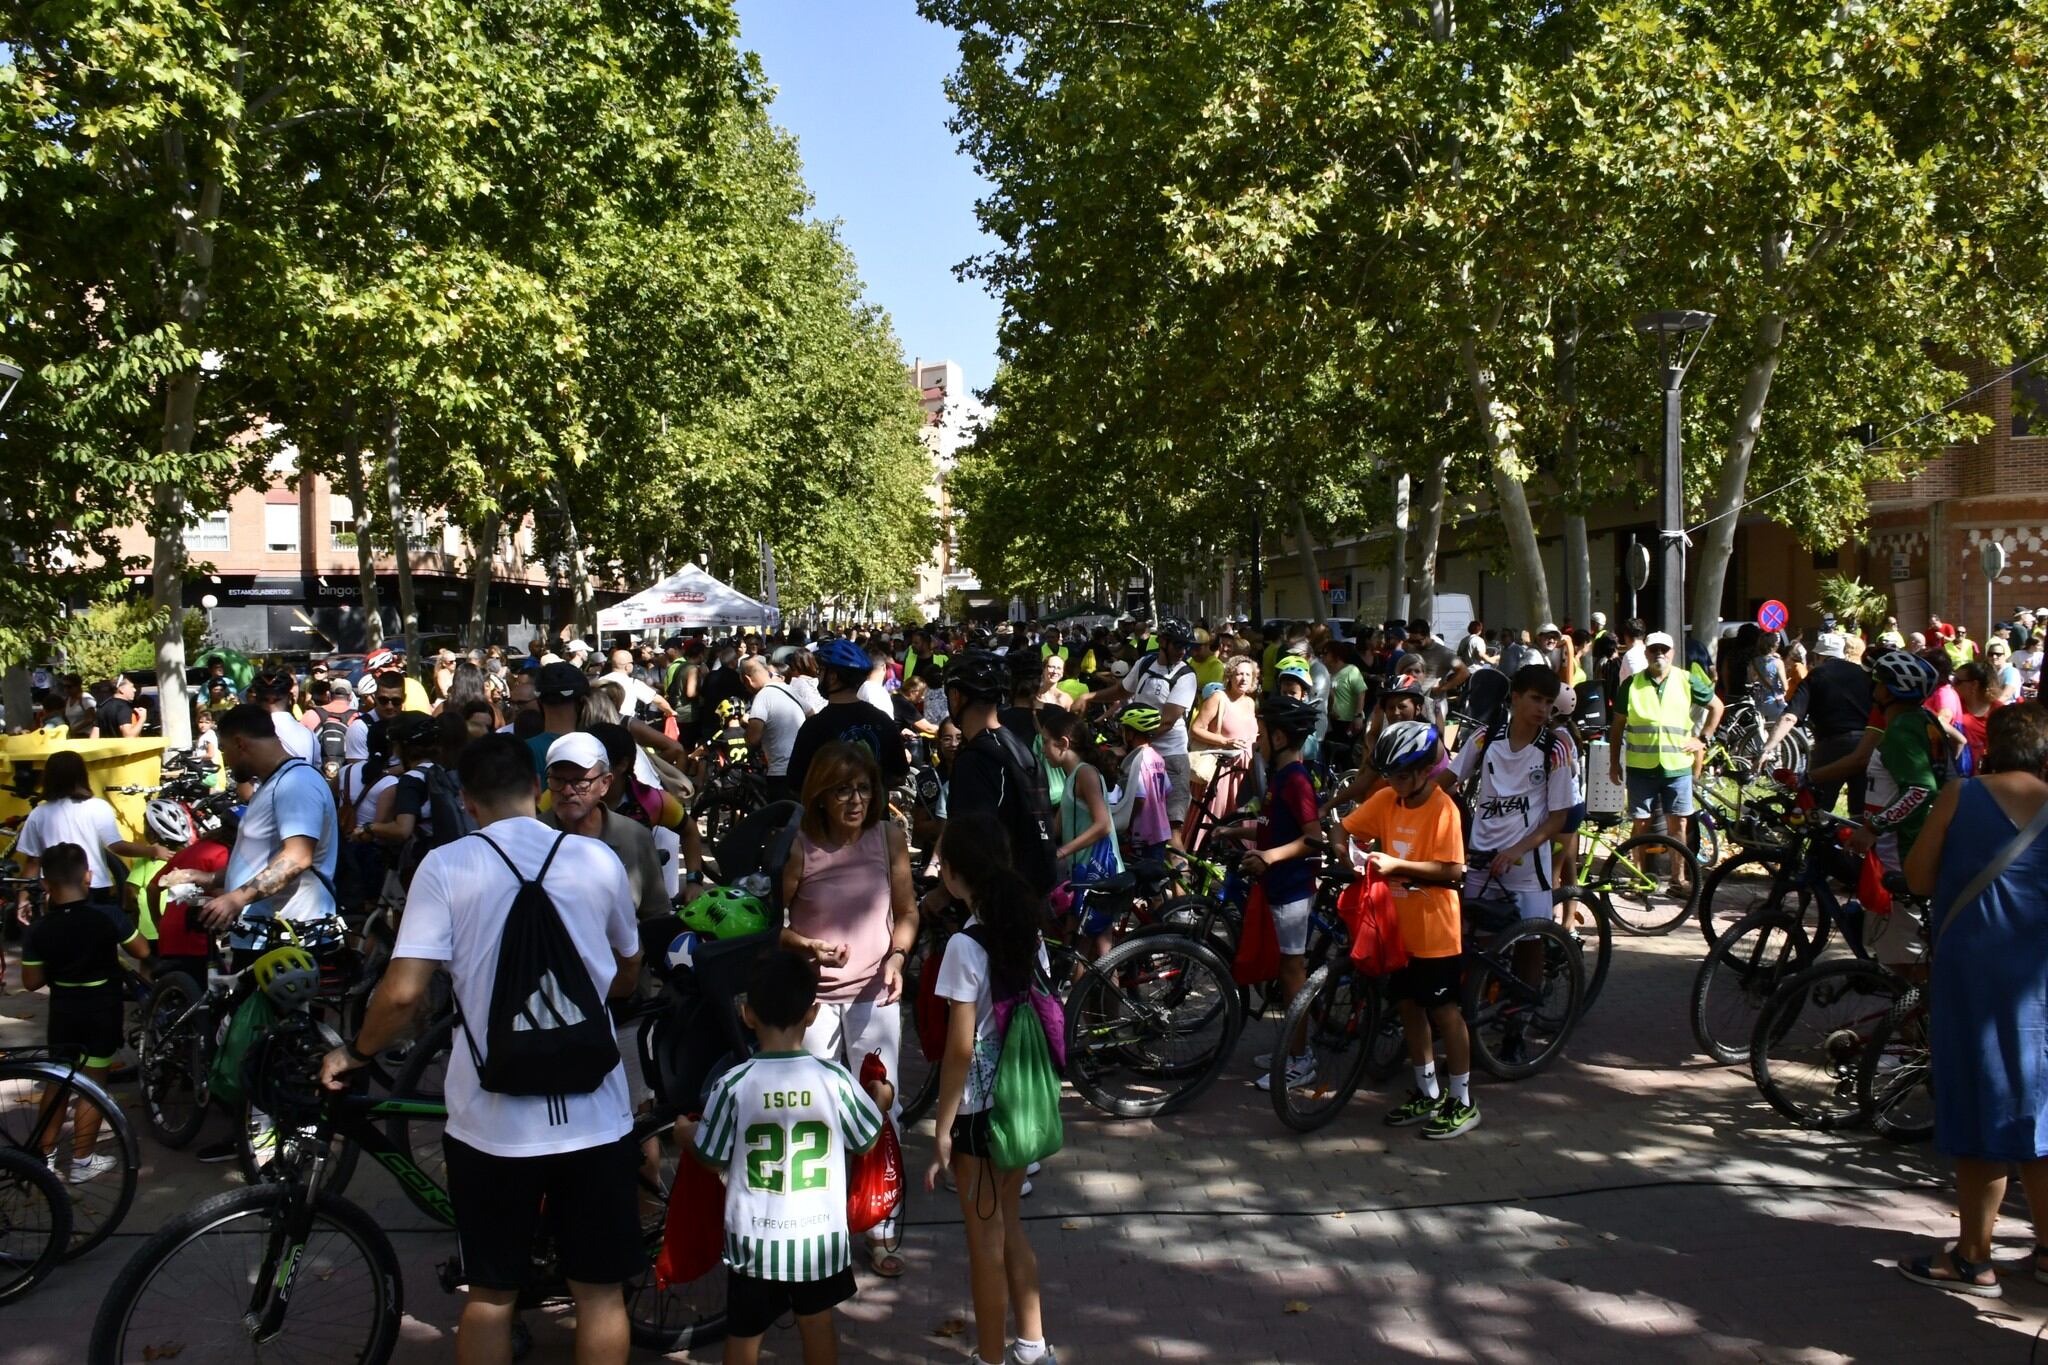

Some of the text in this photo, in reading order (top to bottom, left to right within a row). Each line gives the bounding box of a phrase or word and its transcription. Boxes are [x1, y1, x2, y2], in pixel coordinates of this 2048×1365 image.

[1886, 788, 1927, 822] Castrol
[763, 1091, 811, 1109] ISCO
[744, 1121, 832, 1196] 22
[752, 1215, 797, 1230] FOREVER
